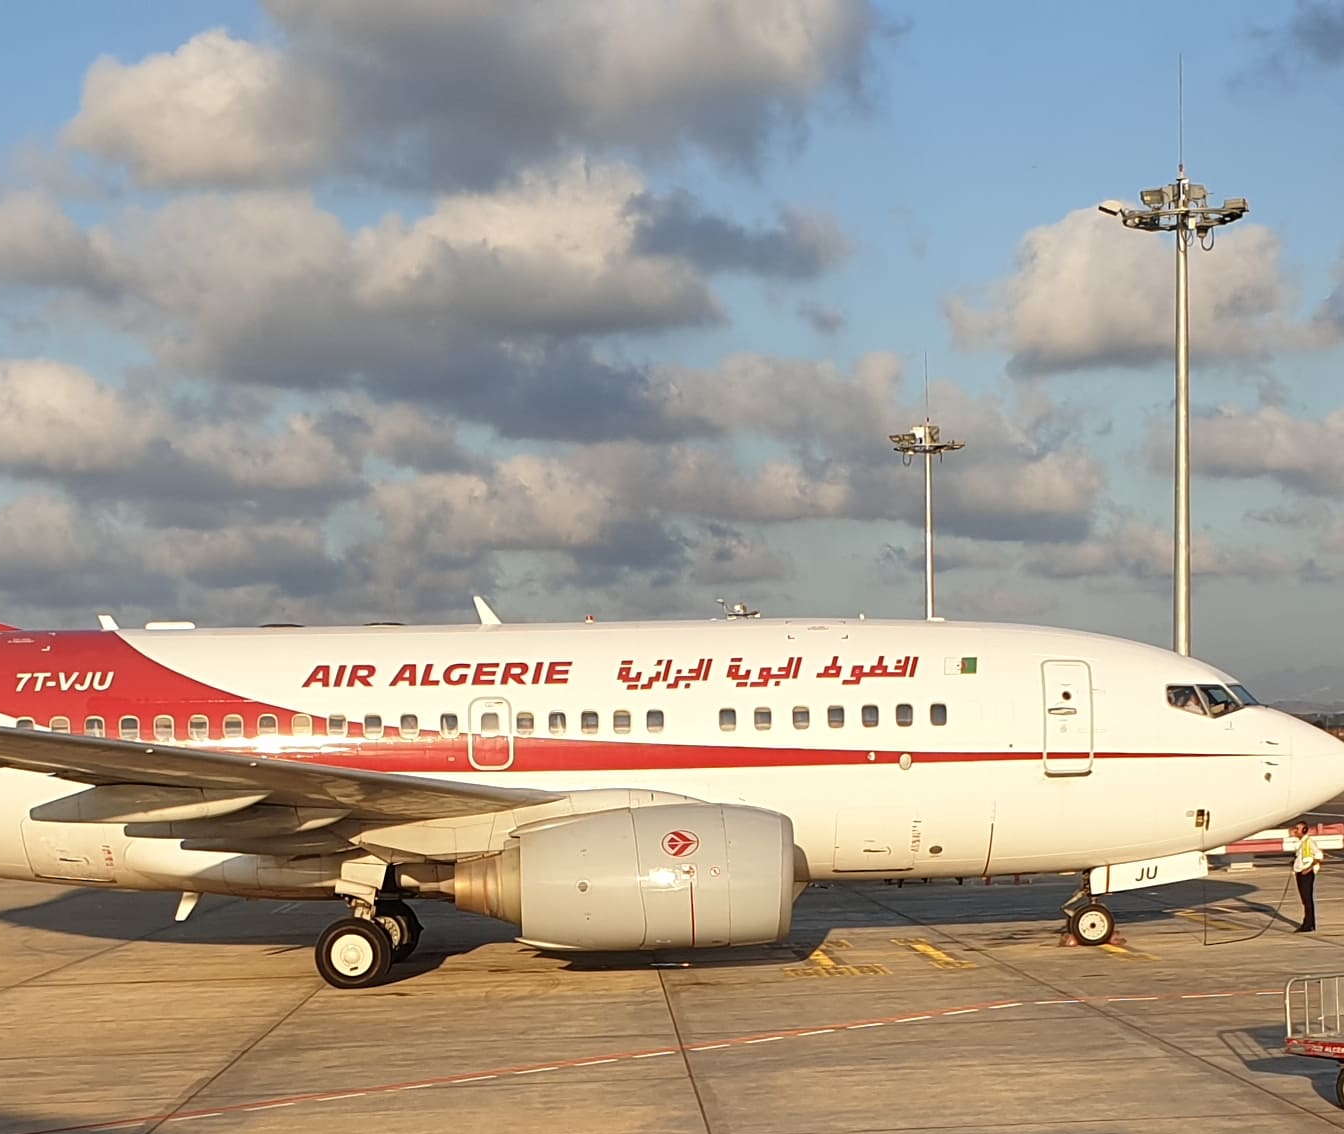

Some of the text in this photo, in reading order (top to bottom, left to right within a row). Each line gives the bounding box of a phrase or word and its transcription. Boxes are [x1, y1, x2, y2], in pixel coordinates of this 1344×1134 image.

[16, 671, 114, 692] 7T-VJU
[302, 661, 573, 688] AIR ALGERIE
[617, 656, 919, 690] الخطوط الجوية الجزائرية
[1135, 865, 1158, 882] JU
